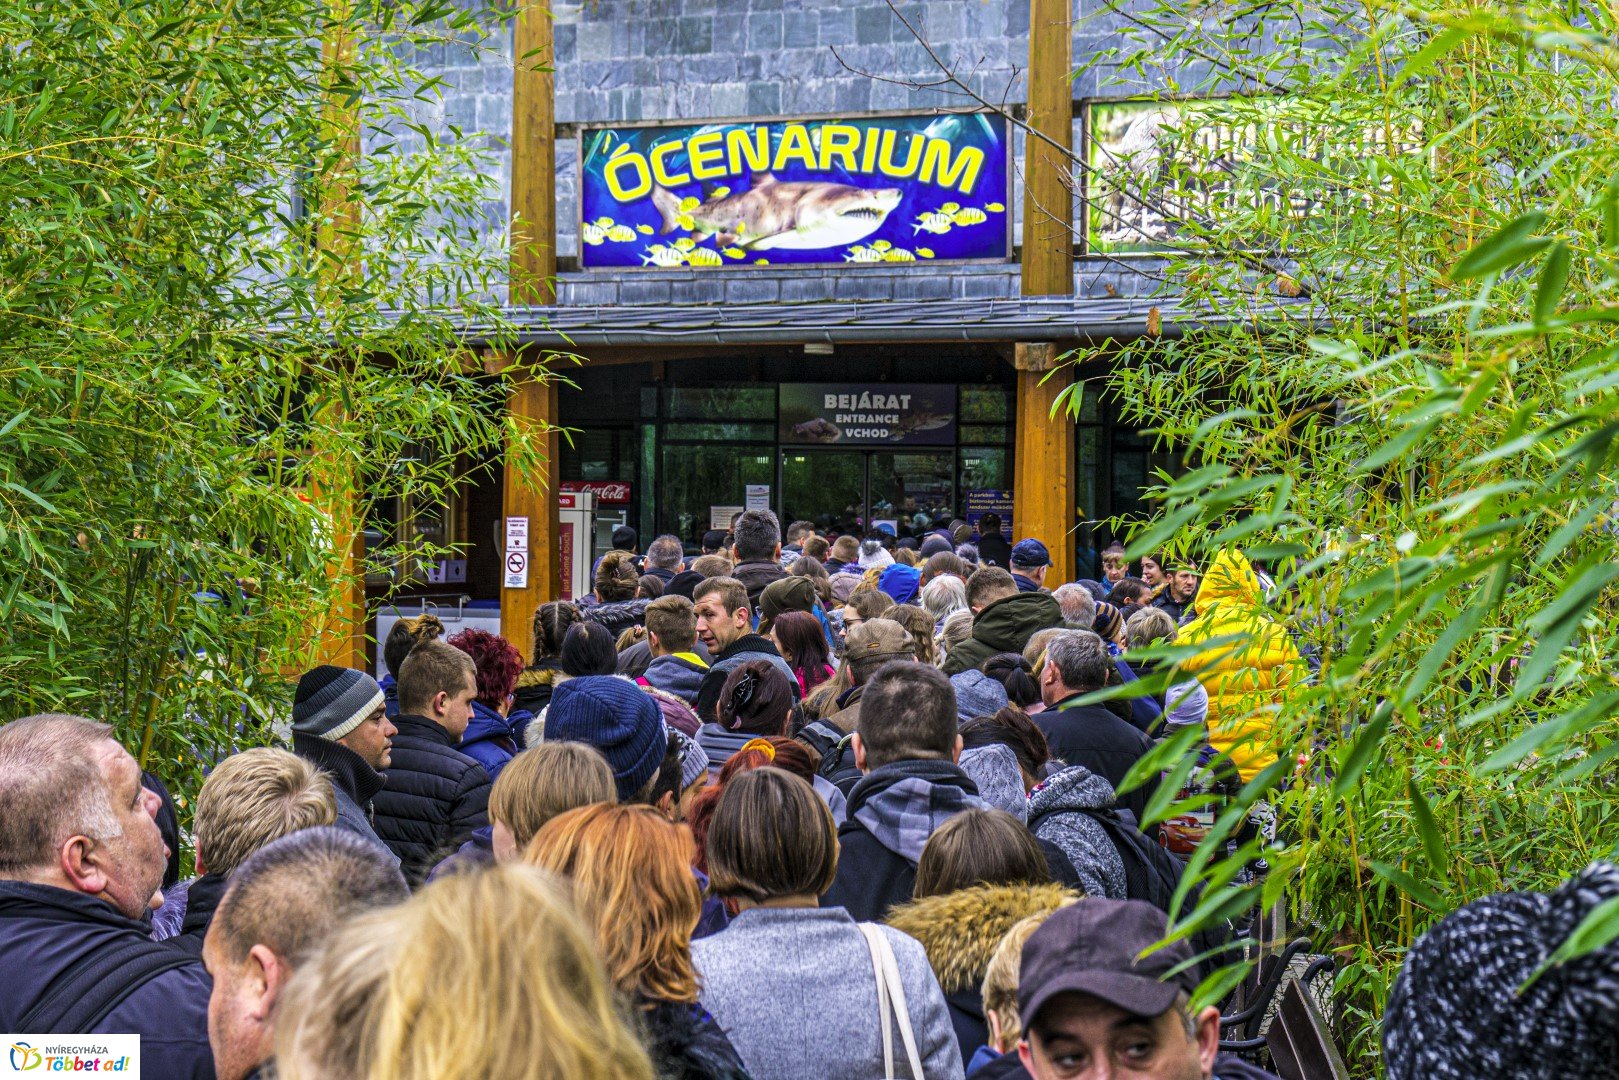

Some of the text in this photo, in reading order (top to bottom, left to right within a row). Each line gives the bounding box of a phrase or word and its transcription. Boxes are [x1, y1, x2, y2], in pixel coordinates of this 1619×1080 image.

[824, 391, 911, 411] BEJÁRAT
[835, 413, 899, 424] ENTRANCE
[845, 427, 889, 438] VCHOD
[562, 532, 570, 554] touch
[562, 579, 572, 593] just
